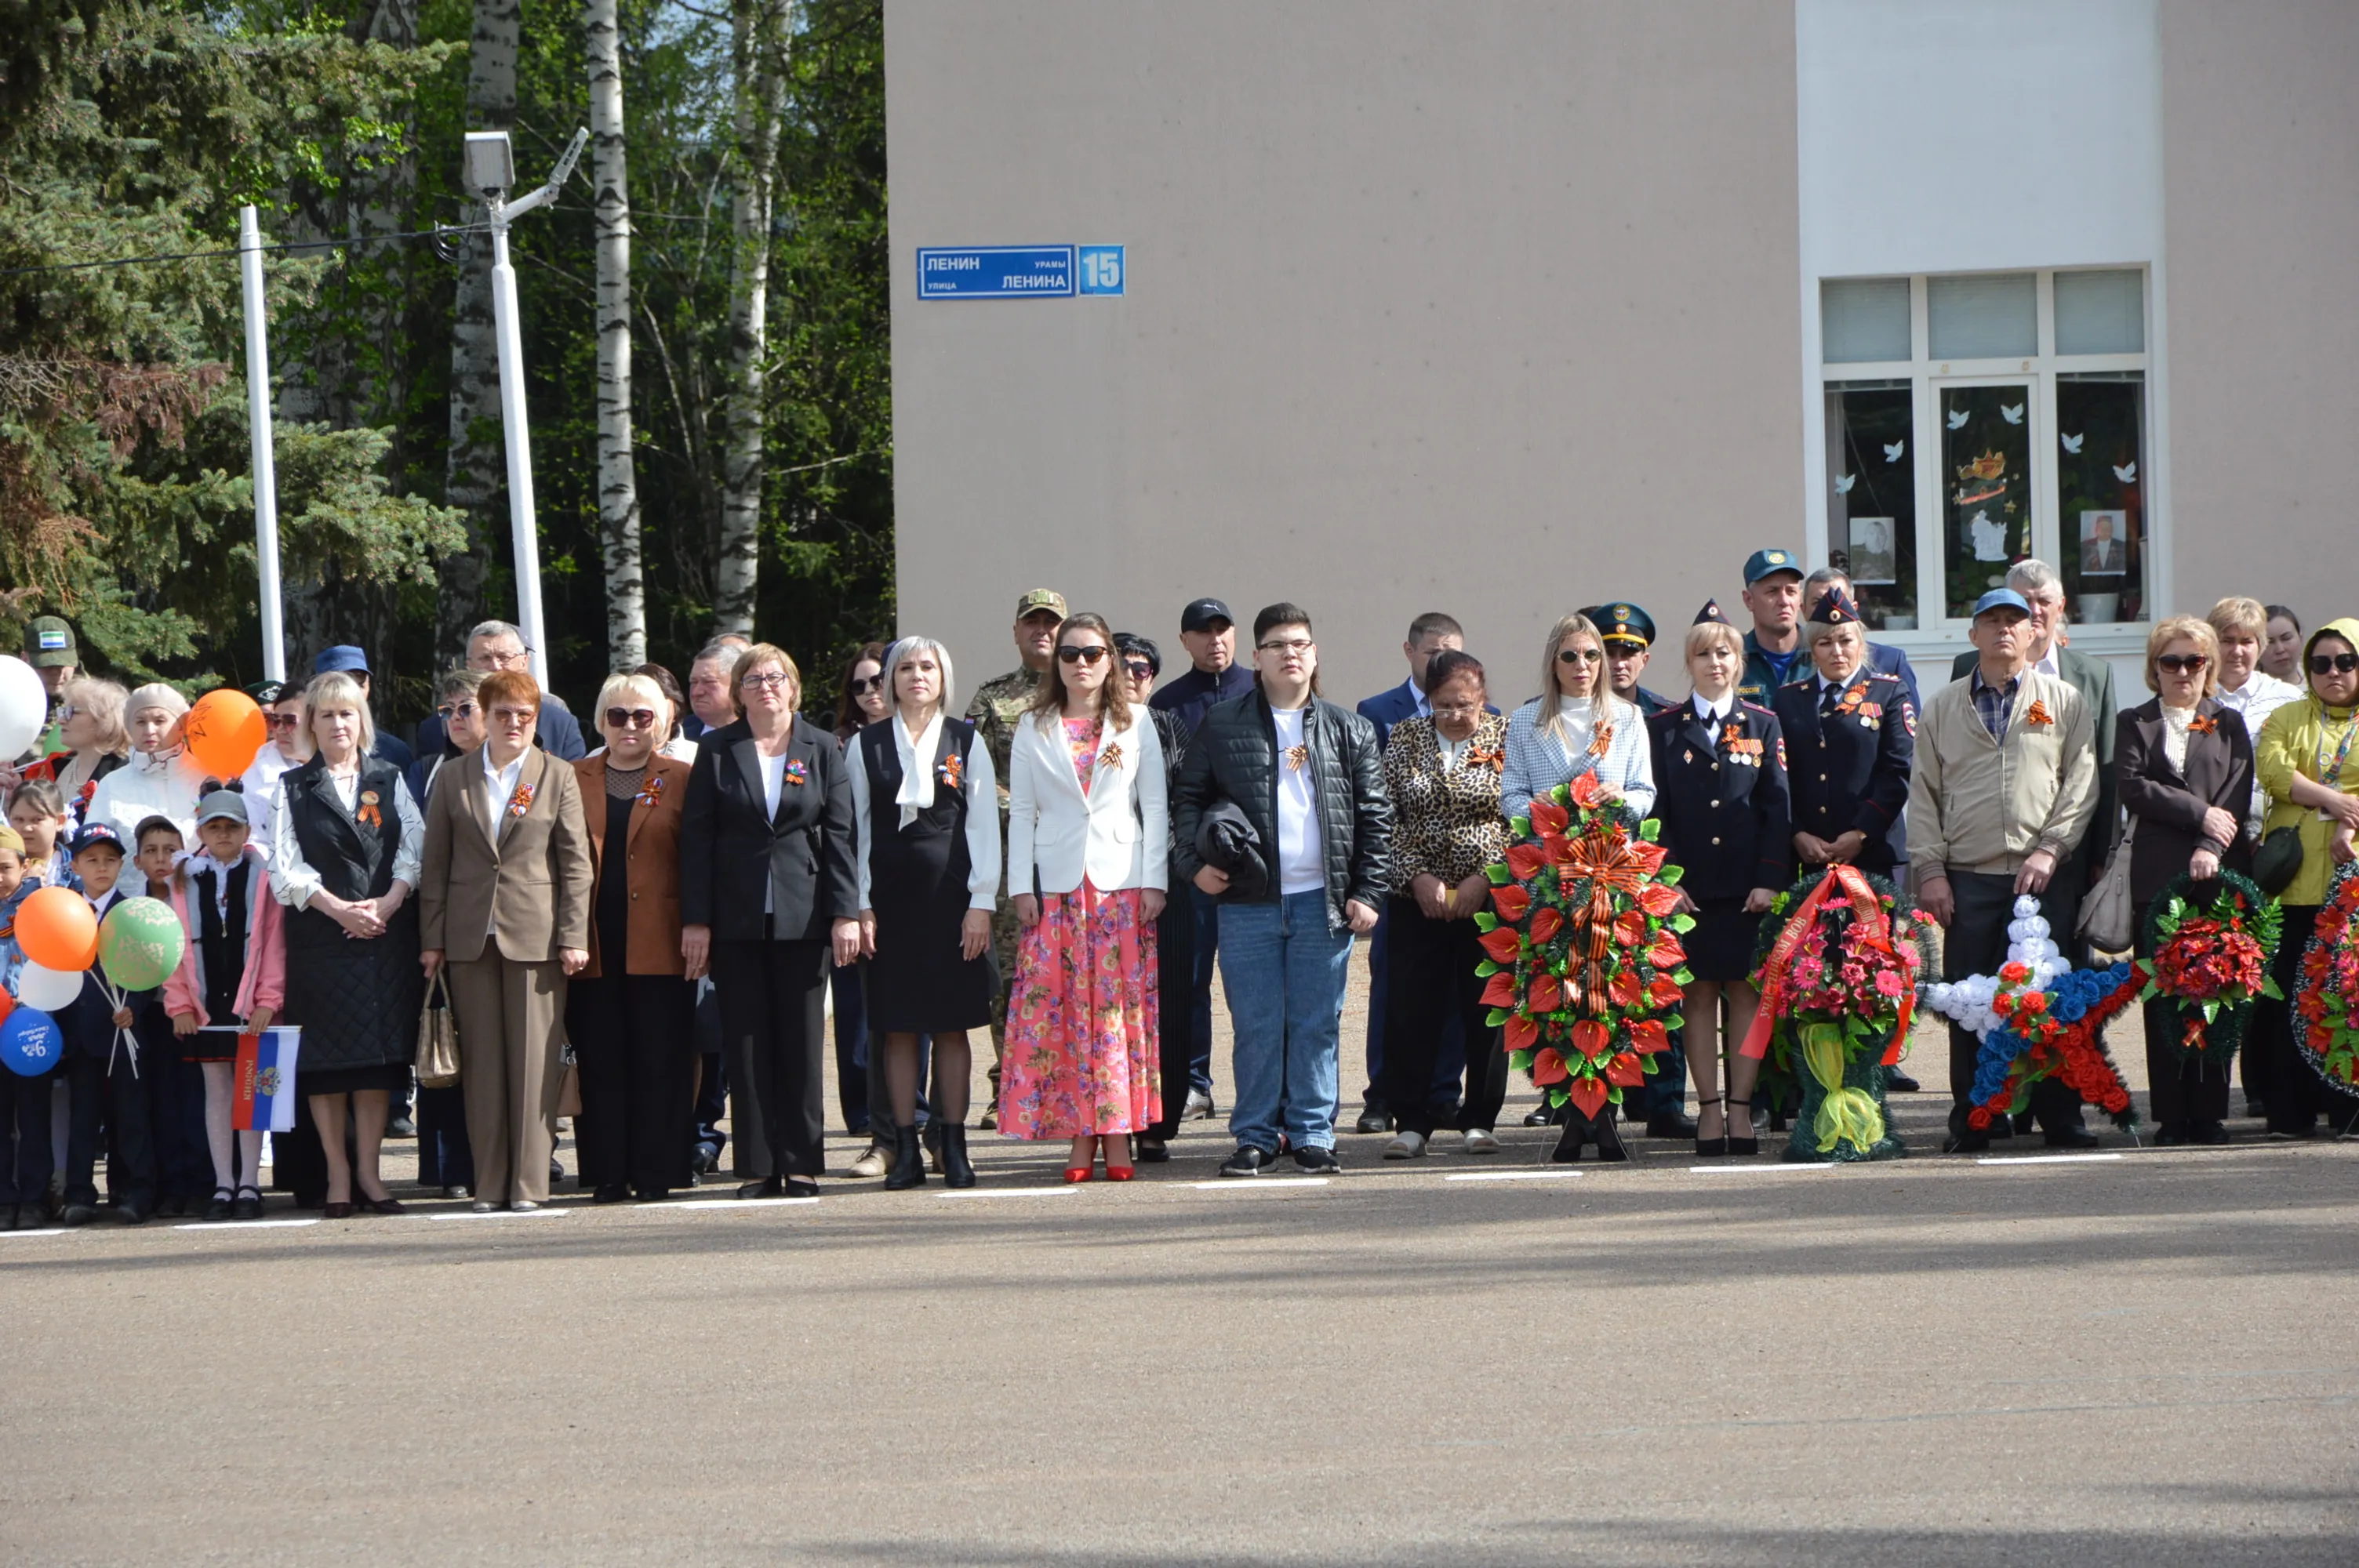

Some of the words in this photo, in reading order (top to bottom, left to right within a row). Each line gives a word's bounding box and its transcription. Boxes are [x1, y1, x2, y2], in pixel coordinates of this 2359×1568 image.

[927, 257, 980, 270] ЛЕНИН
[1035, 260, 1066, 269] УРАМЫ
[1083, 252, 1120, 288] 15
[1002, 275, 1067, 289] ЛЕНИНА
[1760, 938, 1791, 1018] УЧАСТНИКАМ
[1786, 916, 1807, 940] ВОВ
[243, 1059, 255, 1101] РОССИЯ
